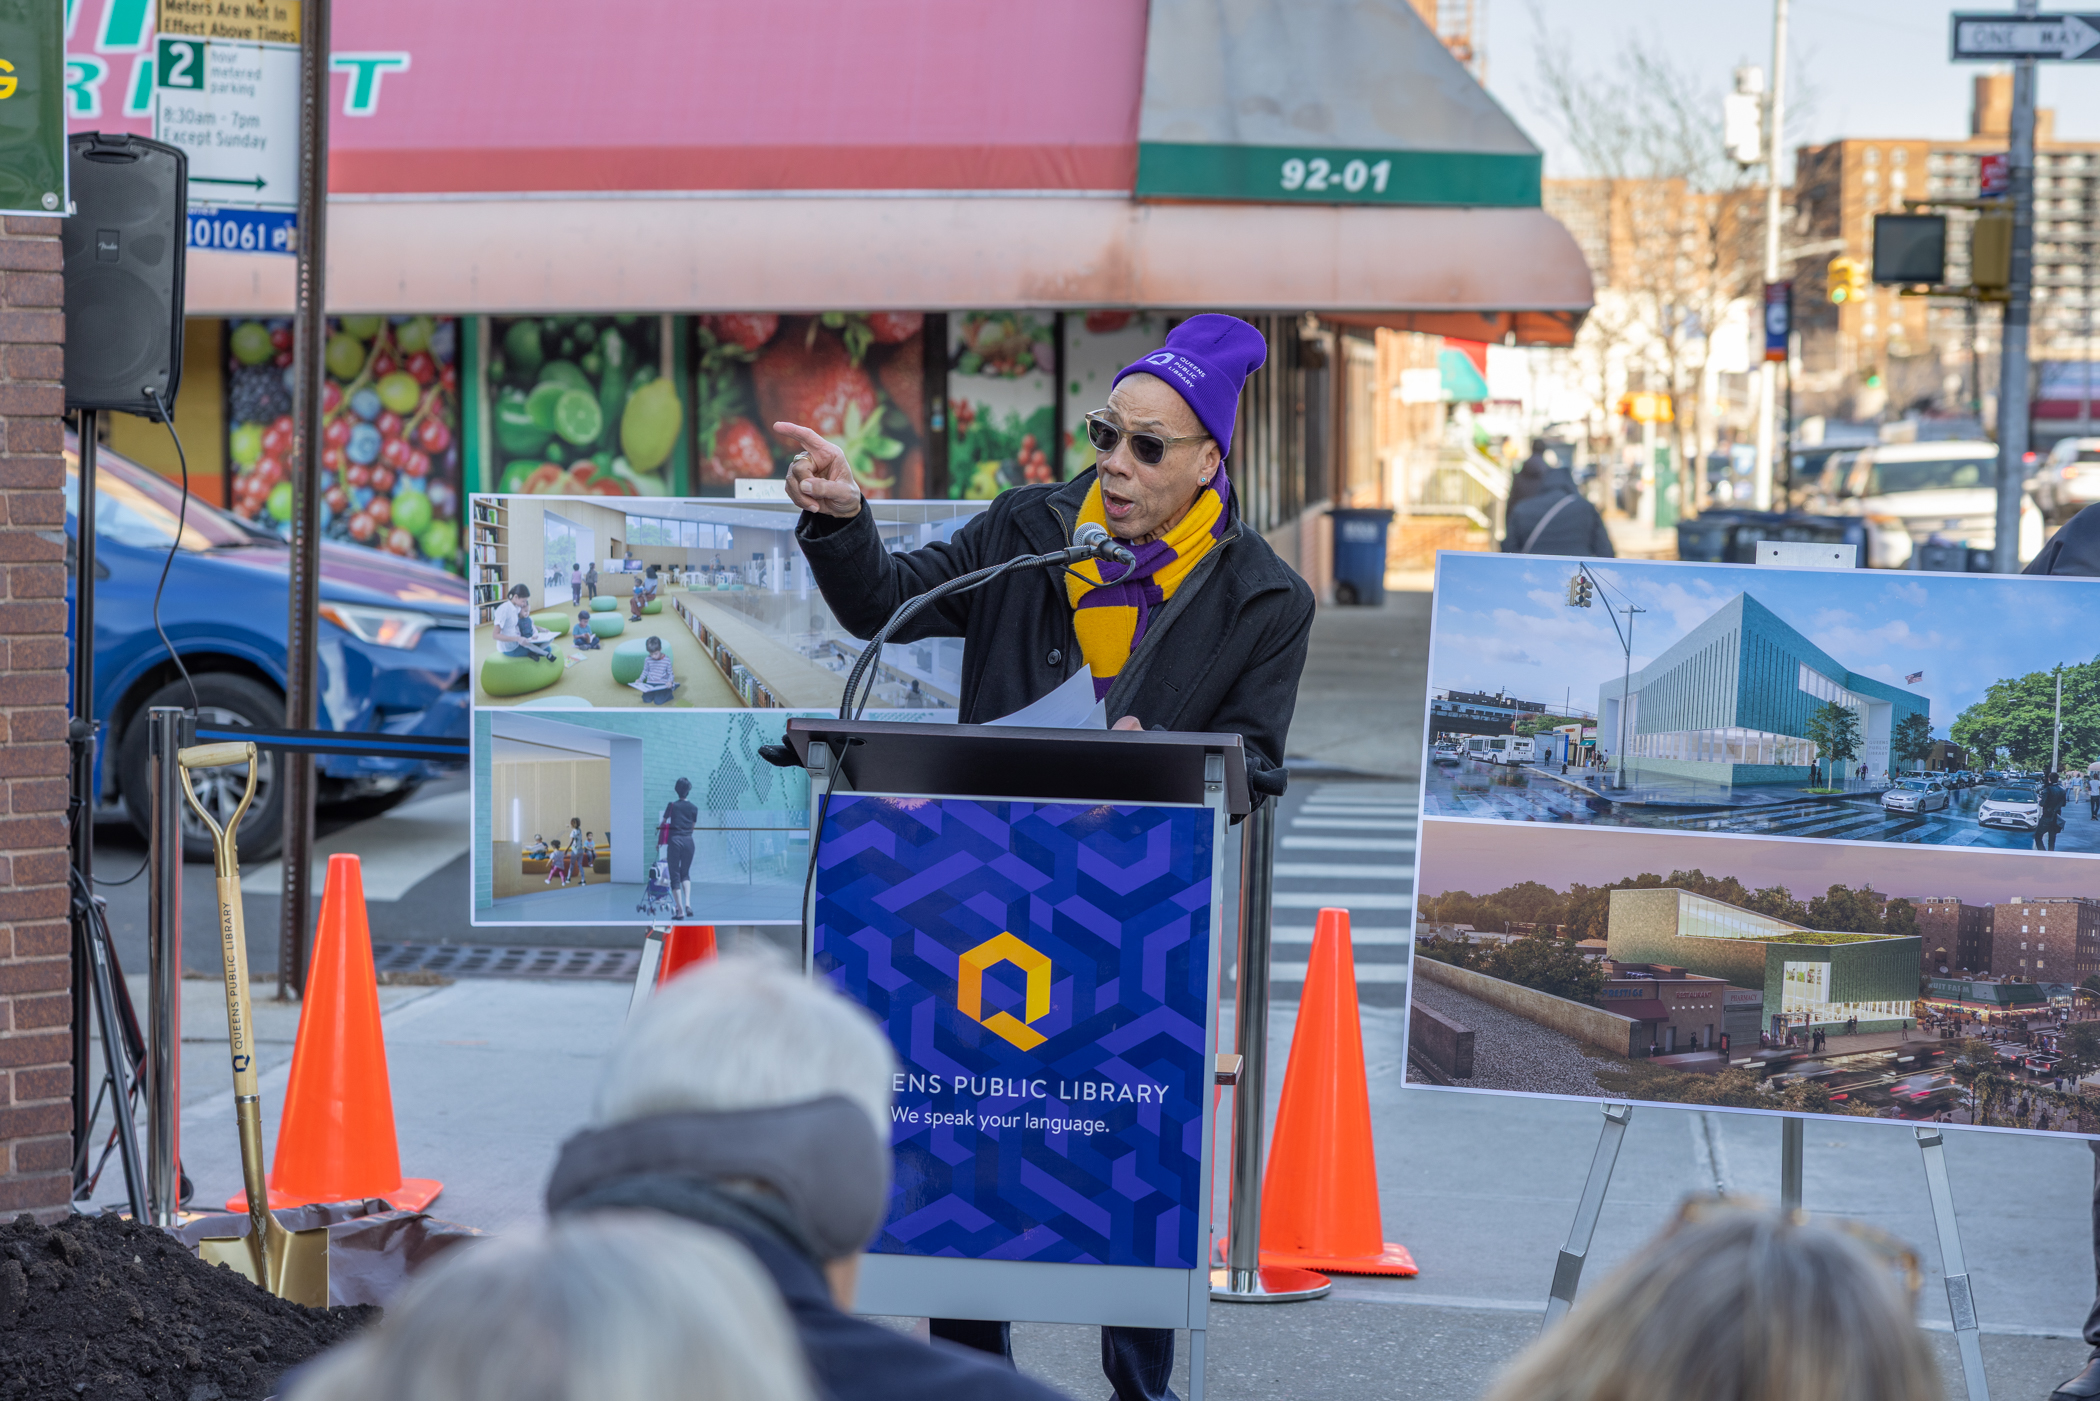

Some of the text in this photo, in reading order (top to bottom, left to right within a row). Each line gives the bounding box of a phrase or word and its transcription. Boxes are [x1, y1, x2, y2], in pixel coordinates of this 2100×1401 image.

[165, 0, 288, 21] Meters Are Not In
[164, 18, 297, 43] Effect Above Times
[1972, 26, 2084, 48] ONE WAY
[168, 42, 195, 87] 2
[211, 50, 238, 63] hour
[210, 66, 262, 81] metered
[210, 82, 255, 97] parking
[164, 106, 216, 126] 8:30am
[230, 110, 261, 130] 7pm
[163, 126, 267, 150] Except Sunday
[1280, 158, 1392, 193] 92-01
[1168, 366, 1194, 388] LIBRARY
[1174, 362, 1197, 380] PUBLIC
[1180, 357, 1206, 378] QUEENS
[223, 902, 243, 1050] QUEENS PUBLIC LIBRARY
[1601, 988, 1643, 998] PRESTIGE
[1676, 991, 1712, 999] RESTAURANT
[1730, 993, 1758, 1002] PHARMACY
[892, 1073, 1169, 1104] ENS PUBLIC LIBRARY
[891, 1105, 1110, 1136] We speak your language.
